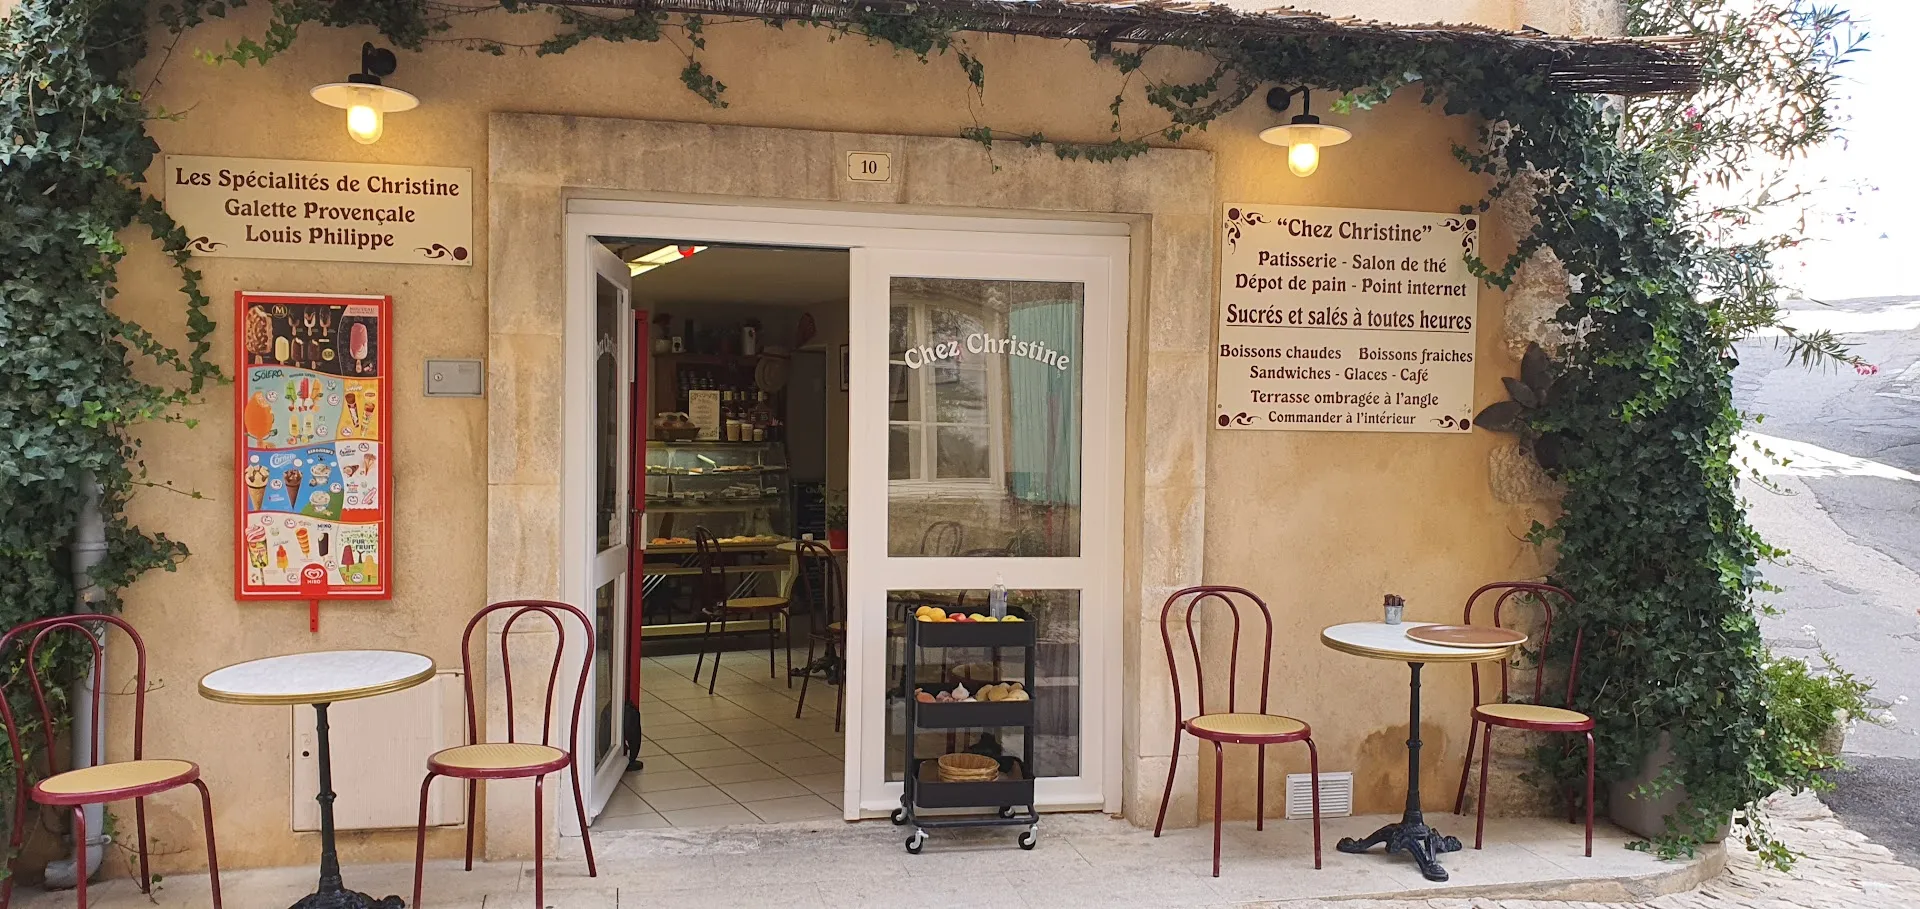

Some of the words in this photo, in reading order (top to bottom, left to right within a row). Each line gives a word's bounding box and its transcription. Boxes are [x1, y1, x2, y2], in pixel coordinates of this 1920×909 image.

[861, 160, 877, 174] 10
[175, 167, 211, 186] Les
[218, 169, 330, 191] Spécialités
[336, 175, 360, 193] de
[367, 175, 460, 197] Christine
[224, 198, 297, 218] Galette
[303, 201, 416, 225] Provençale
[245, 225, 302, 243] Louis
[308, 227, 395, 250] Philippe
[1258, 250, 1337, 268] Patisserie
[1352, 254, 1396, 271] Salon
[1400, 256, 1419, 272] de
[1423, 257, 1447, 273] thé
[1235, 273, 1283, 293] Dépot
[1288, 275, 1307, 291] de
[1311, 277, 1347, 295] pain
[1361, 278, 1403, 294] Point
[1407, 279, 1467, 297] internet
[1226, 303, 1283, 324] Sucrés
[1288, 307, 1303, 325] et
[1307, 306, 1348, 326] salés
[1353, 307, 1362, 327] à
[1367, 310, 1415, 329] toutes
[1419, 309, 1472, 330] heures
[904, 339, 961, 370] Chez
[966, 333, 1070, 371] Christine
[1220, 344, 1282, 359] Boissons
[1286, 345, 1342, 360] chaudes
[1358, 347, 1418, 362] Boissons
[1420, 348, 1473, 364] fraiches
[1249, 366, 1331, 380] Sandwiches
[1344, 367, 1388, 381] Glaces
[1400, 368, 1429, 384] Café
[1250, 390, 1310, 404] Terrasse
[1314, 390, 1380, 408] ombragée
[1384, 392, 1392, 405] à
[1396, 392, 1439, 409] l’angle
[1268, 410, 1343, 424] Commander
[1346, 411, 1353, 424] à
[1356, 411, 1417, 425] l’intérieur
